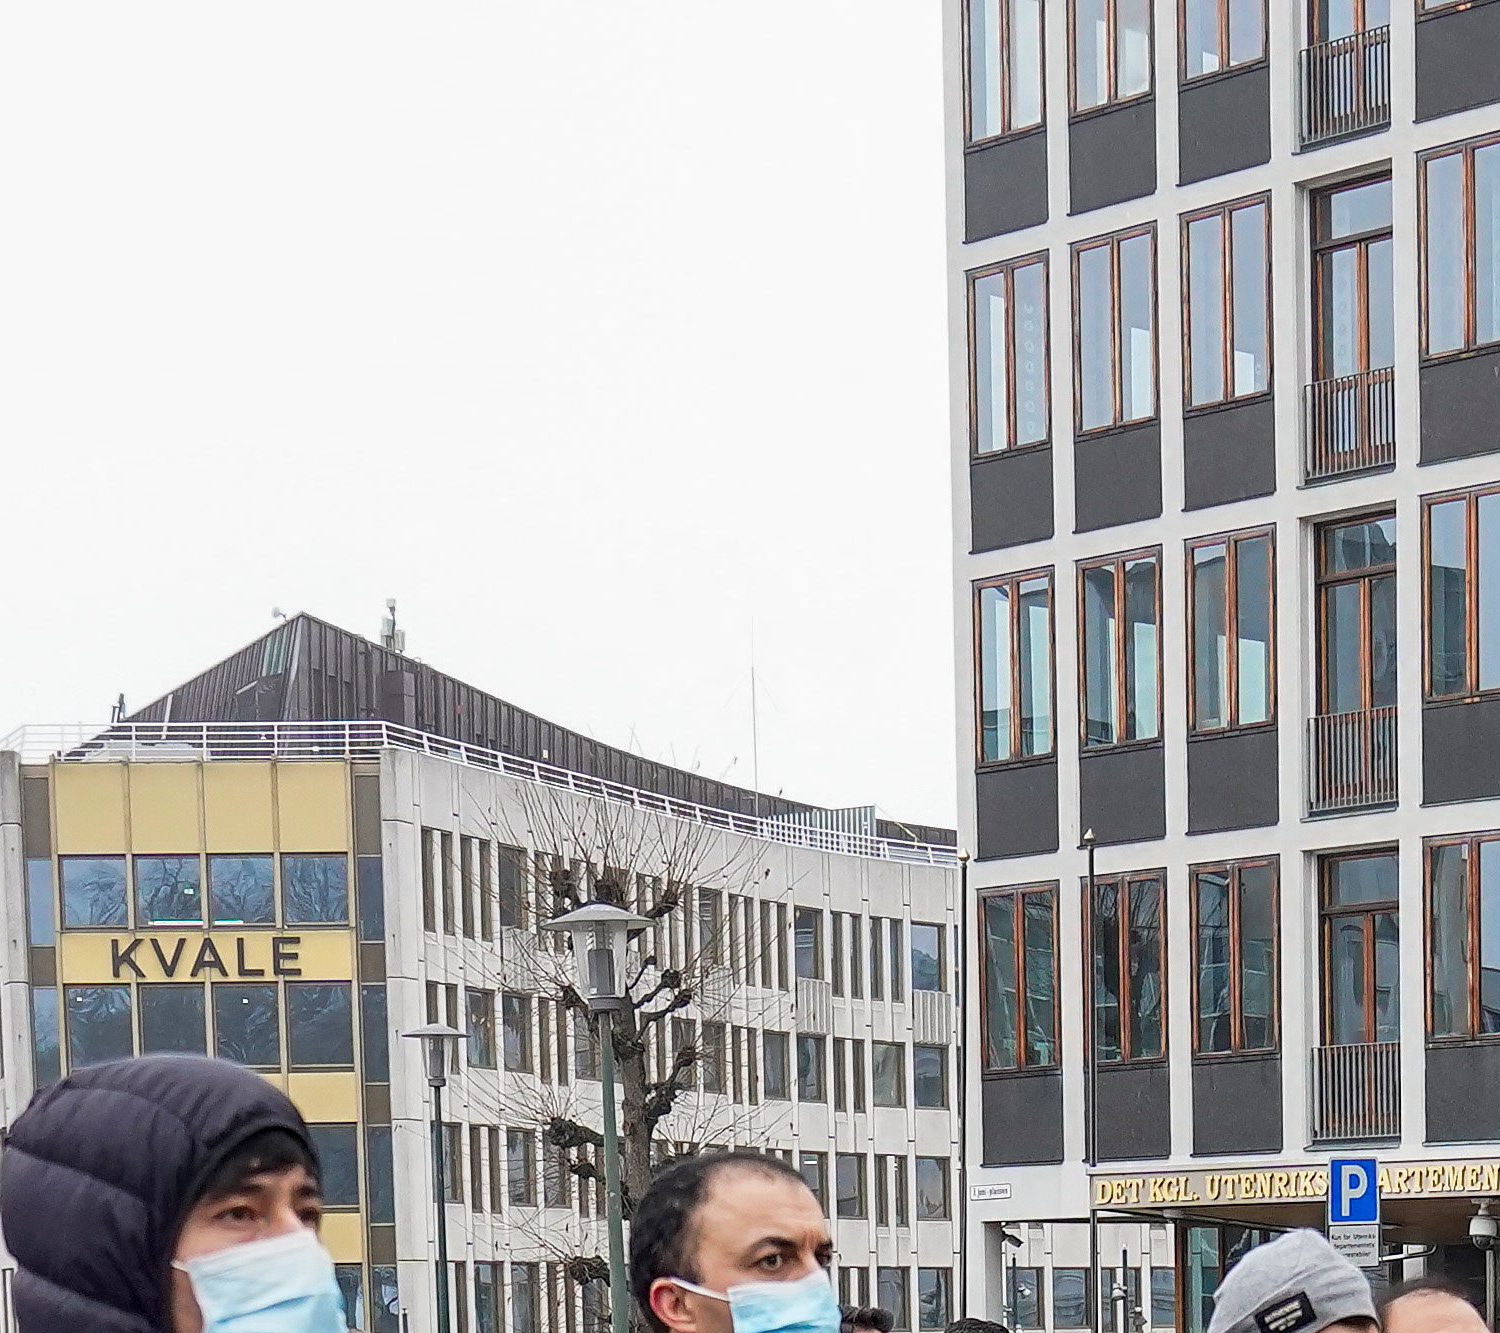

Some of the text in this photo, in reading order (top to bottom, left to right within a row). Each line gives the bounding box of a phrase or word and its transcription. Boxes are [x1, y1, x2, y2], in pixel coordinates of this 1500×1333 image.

[111, 936, 302, 978] KVALE
[1095, 1176, 1146, 1205] DET
[1149, 1174, 1200, 1202] KGL.
[1341, 1164, 1368, 1217] P
